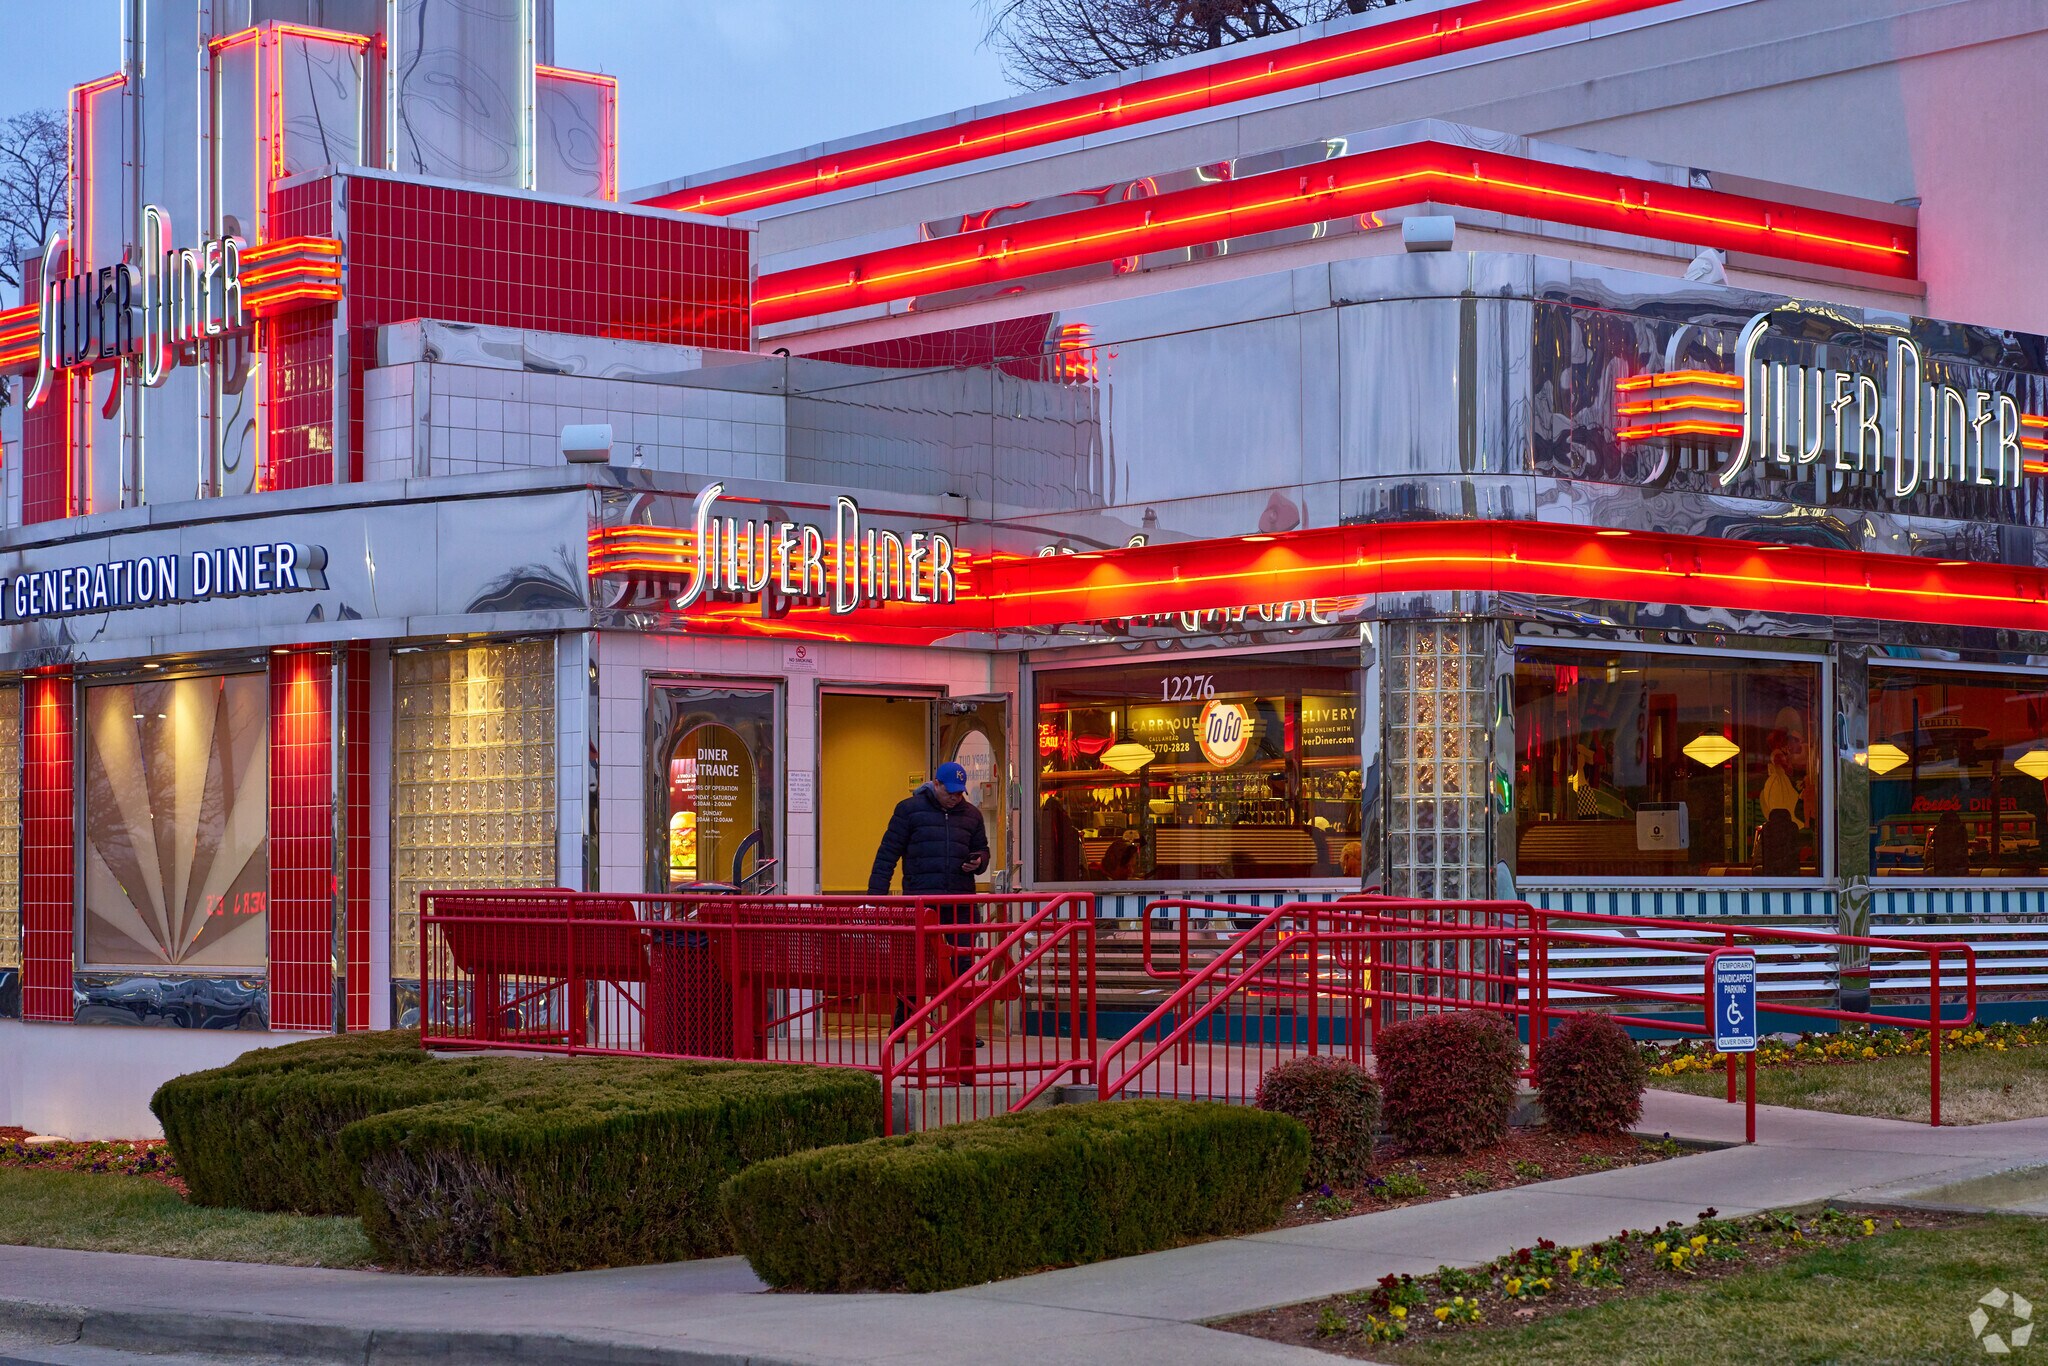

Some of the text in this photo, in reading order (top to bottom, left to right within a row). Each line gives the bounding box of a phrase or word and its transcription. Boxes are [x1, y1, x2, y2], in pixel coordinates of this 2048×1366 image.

[14, 554, 179, 618] GENERATION
[192, 541, 299, 597] DINER
[1160, 674, 1215, 702] 12276
[1336, 725, 1351, 733] WITH
[697, 748, 728, 761] DINER
[1719, 962, 1752, 970] TEMPORARY
[1717, 973, 1753, 984] HANDICAPPED
[1724, 985, 1747, 994] PARKING
[1720, 1038, 1737, 1046] SILVER
